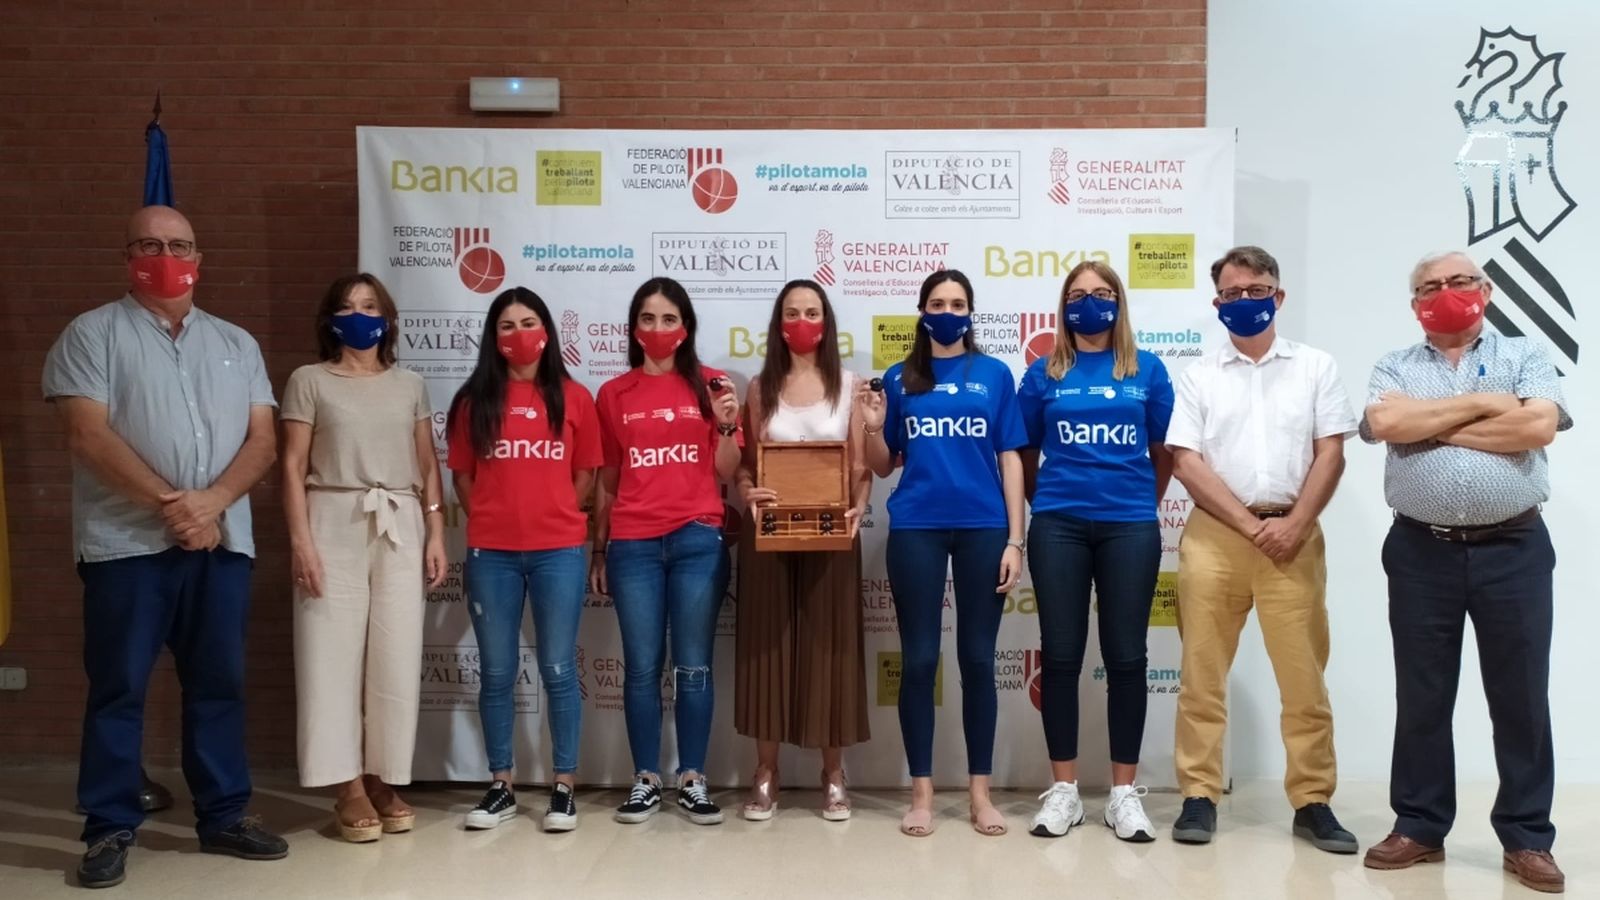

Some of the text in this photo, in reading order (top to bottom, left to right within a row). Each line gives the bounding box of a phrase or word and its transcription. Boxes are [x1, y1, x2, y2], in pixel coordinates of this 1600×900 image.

[627, 147, 687, 160] FEDERACIÓ
[892, 157, 1012, 168] DIPUTACIÓ DE
[1076, 160, 1186, 174] GENERALITAT
[546, 167, 594, 177] treballant
[633, 164, 686, 174] DE PILOTA
[755, 164, 867, 180] #pilotamola
[391, 160, 518, 193] Bankia
[622, 179, 686, 189] VALENCIANA
[1078, 177, 1183, 191] VALENCIANA
[399, 241, 453, 253] DE PILOTA
[659, 238, 779, 249] DIPUTACIÓ DE
[842, 243, 949, 256] GENERALITAT
[522, 244, 634, 261] #pilotamola
[1138, 251, 1186, 260] treballant
[389, 256, 453, 268] VALENCIANA
[843, 260, 946, 273] VALENCIANA
[404, 318, 482, 328] DIPUTACI
[973, 313, 1020, 324] DERACIÓ
[881, 332, 914, 341] treball
[983, 328, 1019, 339] PILOTA
[1135, 328, 1202, 343] tamola
[404, 330, 481, 350] VALÈN
[979, 344, 1019, 354] NCIANA
[905, 416, 987, 440] Bankia
[1057, 420, 1137, 445] Bankia
[995, 649, 1024, 660] RACIÓ
